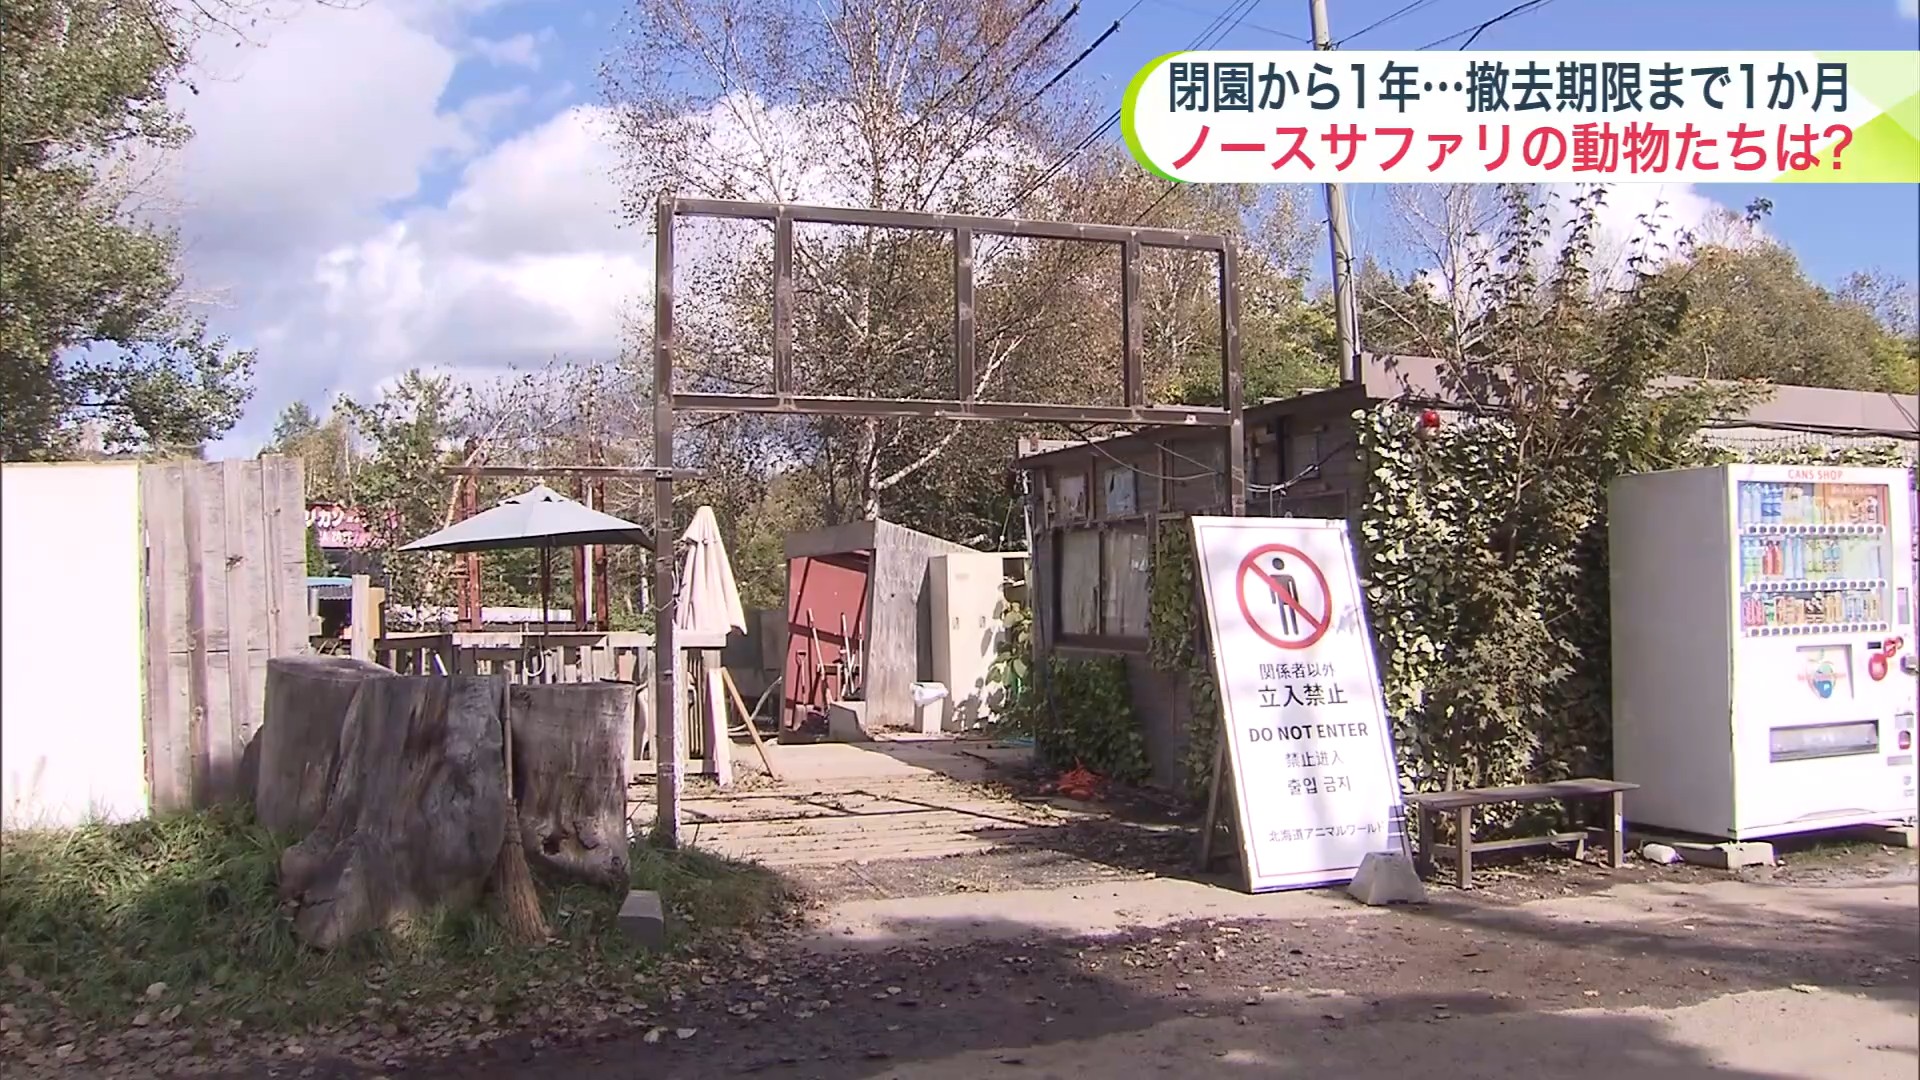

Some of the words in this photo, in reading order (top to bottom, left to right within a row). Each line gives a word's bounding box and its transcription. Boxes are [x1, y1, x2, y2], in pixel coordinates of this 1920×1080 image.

[1788, 469, 1816, 480] CANS
[1818, 469, 1844, 481] SHOP
[1259, 662, 1335, 680] 関係者以外
[1258, 683, 1348, 708] 立入禁止
[1249, 727, 1273, 742] DO
[1278, 725, 1312, 741] NOT
[1317, 722, 1368, 738] ENTER
[1285, 750, 1344, 768] 禁止进入
[1288, 777, 1318, 795] 출입
[1323, 776, 1351, 793] 금지
[1268, 821, 1385, 842] 北海道アニマルワールド
